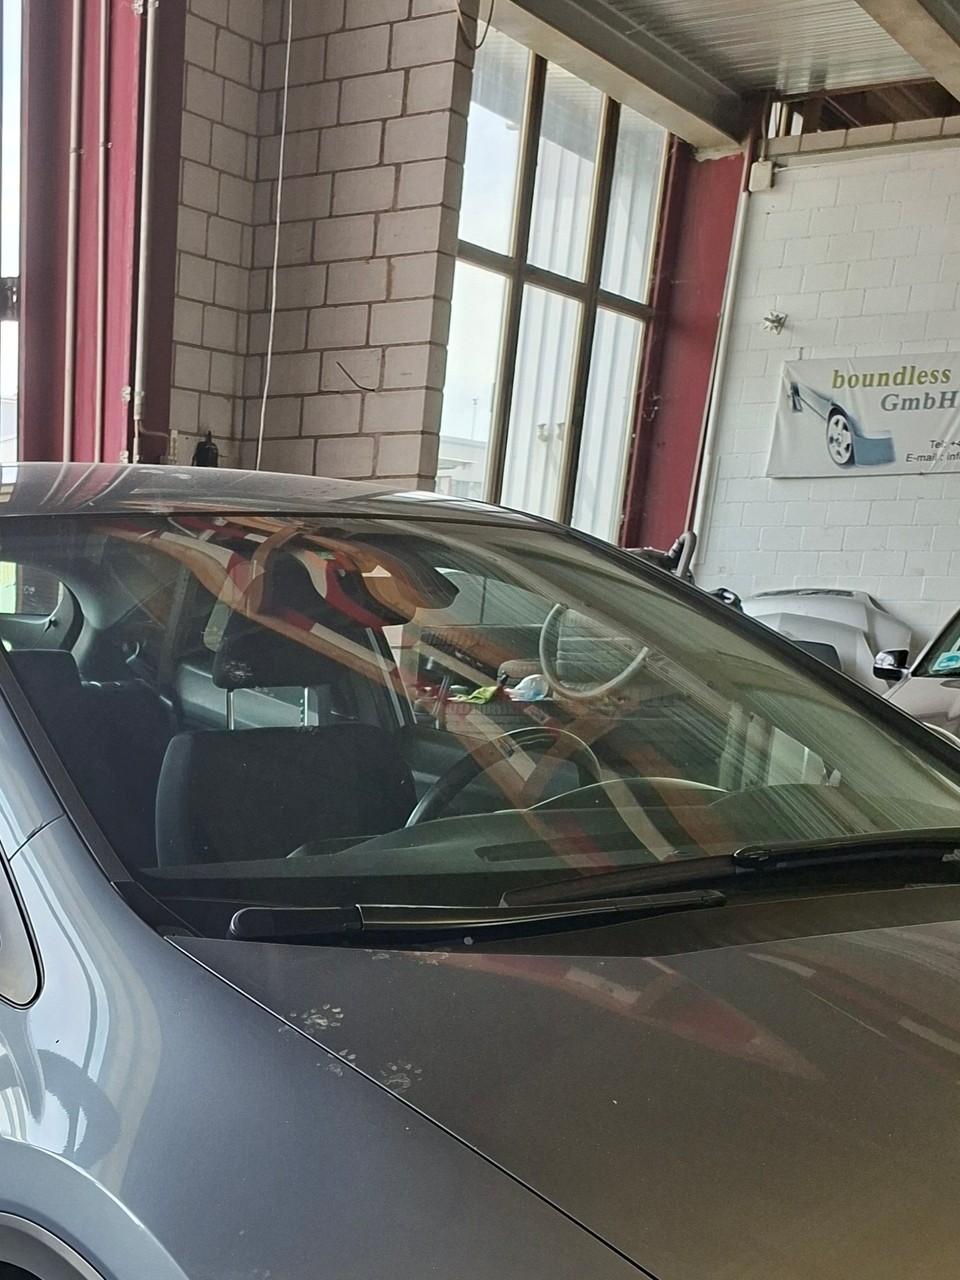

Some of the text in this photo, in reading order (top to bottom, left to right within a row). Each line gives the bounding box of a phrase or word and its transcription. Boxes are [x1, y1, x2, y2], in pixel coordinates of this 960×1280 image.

[832, 366, 951, 389] boundless
[881, 391, 959, 411] GmbH
[946, 452, 960, 461] inf
